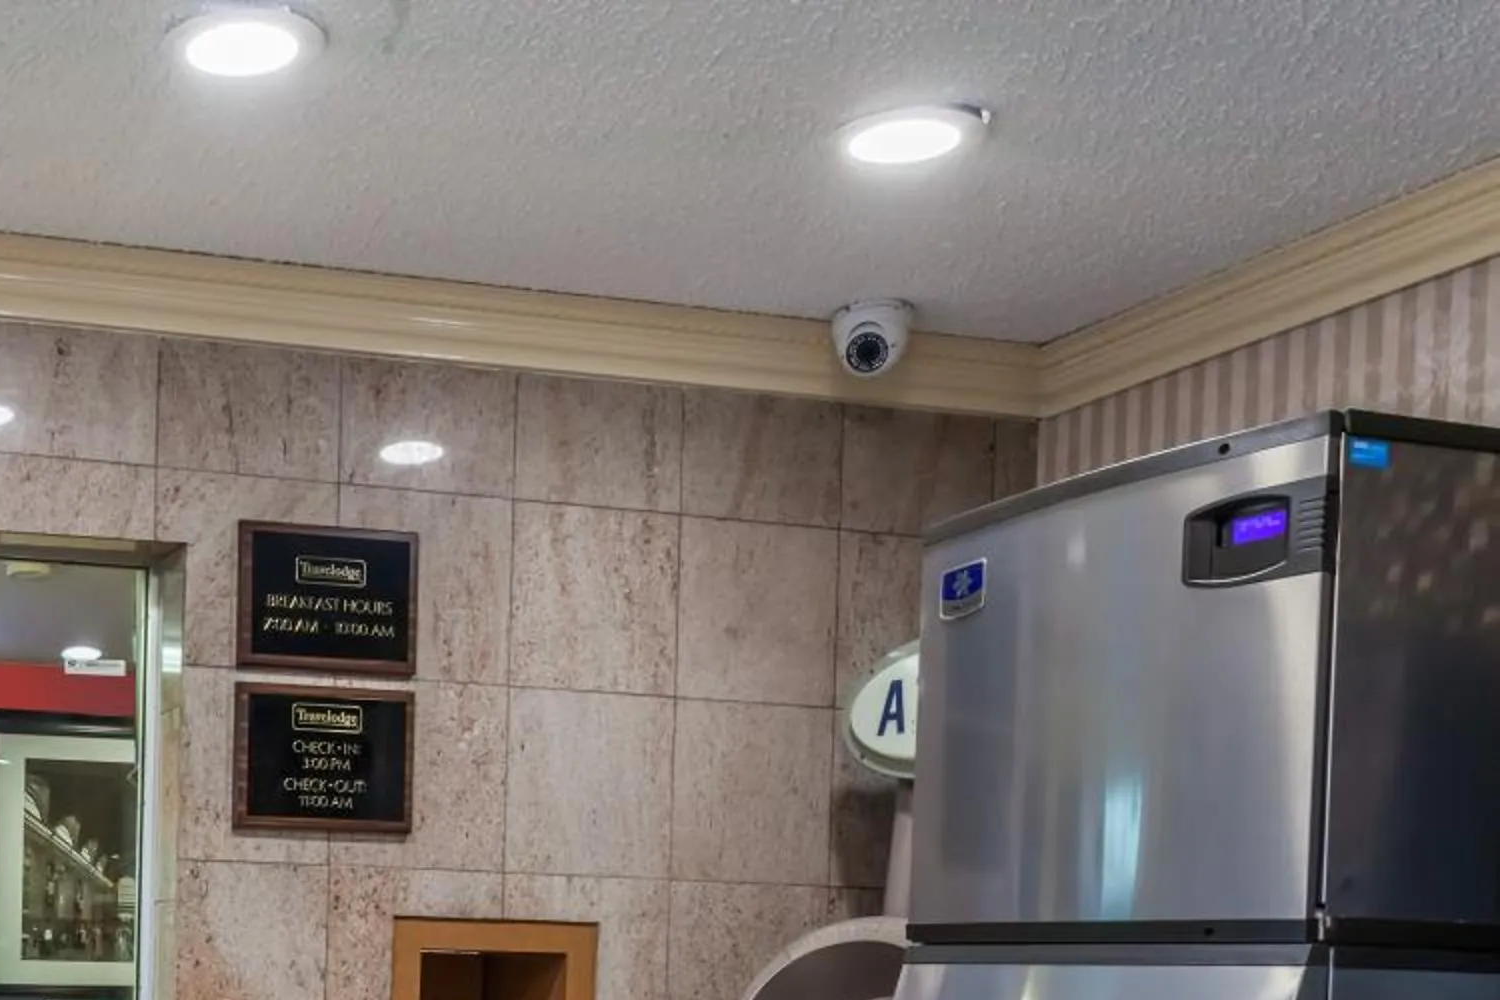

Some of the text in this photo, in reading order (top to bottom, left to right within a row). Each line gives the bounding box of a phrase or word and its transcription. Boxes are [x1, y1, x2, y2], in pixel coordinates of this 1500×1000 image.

[301, 561, 363, 581] Travelodge
[267, 593, 393, 616] BREAKFAST HOURS
[294, 618, 319, 633] AM
[370, 623, 395, 638] AM
[298, 709, 358, 727] Travelodge
[331, 757, 351, 771] PM
[331, 797, 354, 810] AM
